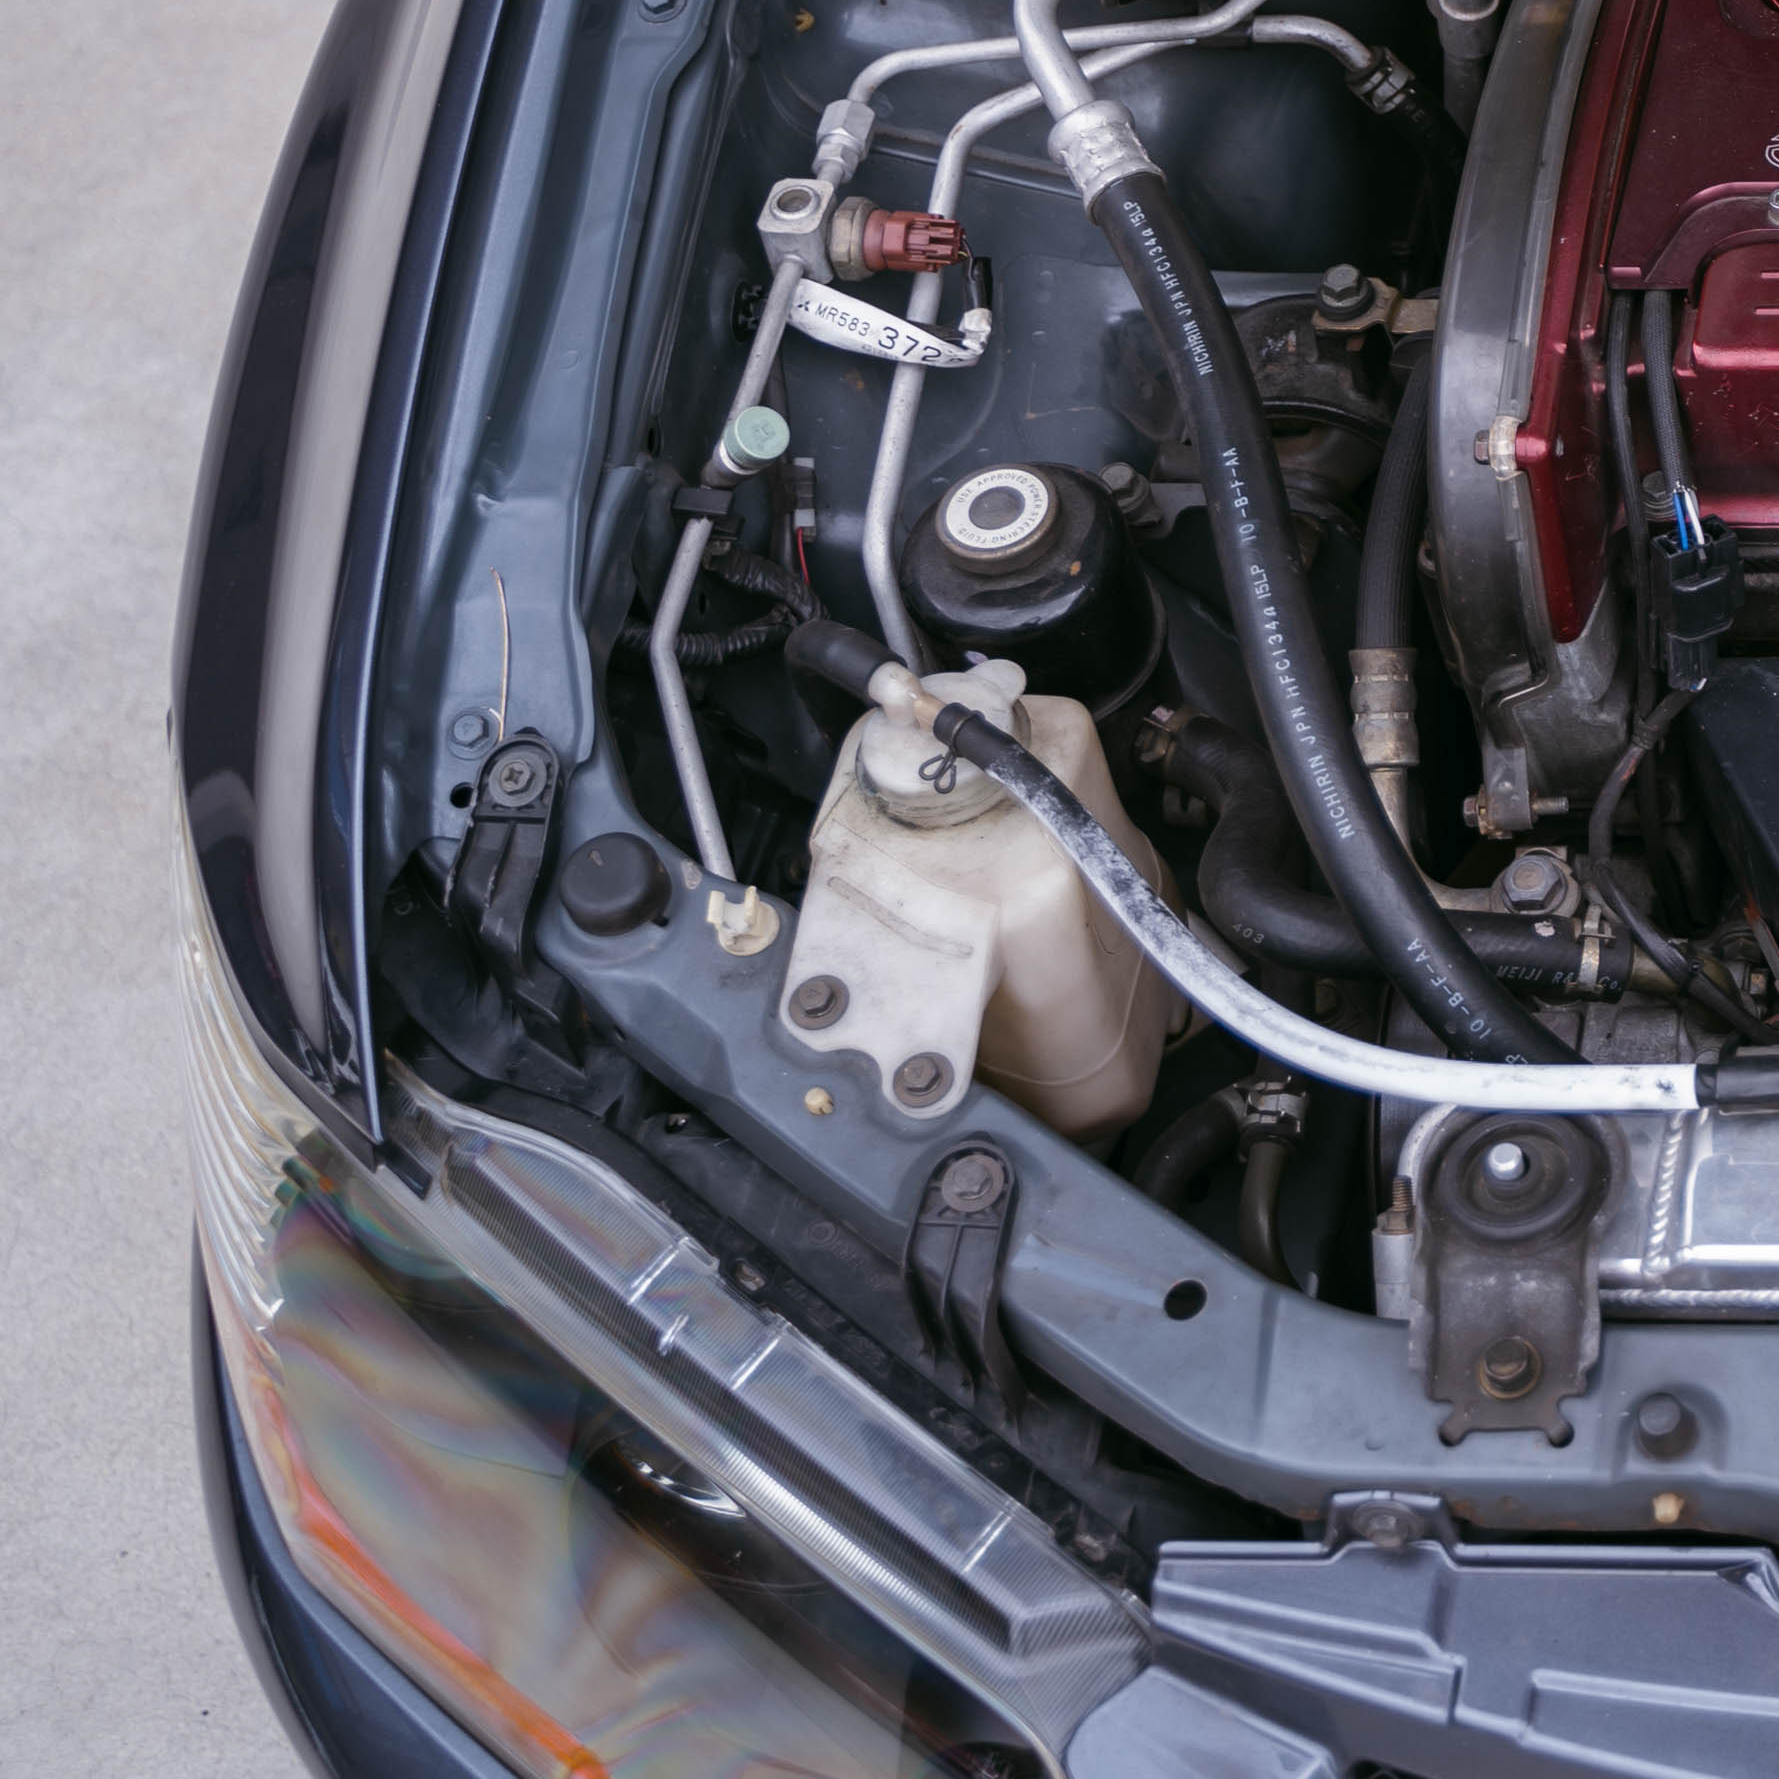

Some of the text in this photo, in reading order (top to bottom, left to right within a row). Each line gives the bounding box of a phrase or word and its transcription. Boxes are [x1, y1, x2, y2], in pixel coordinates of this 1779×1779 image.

[1170, 291, 1192, 316] JPN
[815, 302, 871, 338] MR583
[1183, 320, 1214, 376] NICHIRIN
[976, 472, 1028, 487] APPROVED
[957, 488, 972, 504] USE
[1028, 483, 1042, 509] POWER
[991, 512, 1039, 544] STEERING
[1289, 707, 1317, 745] JPN
[1308, 755, 1356, 840] NICHIRIN
